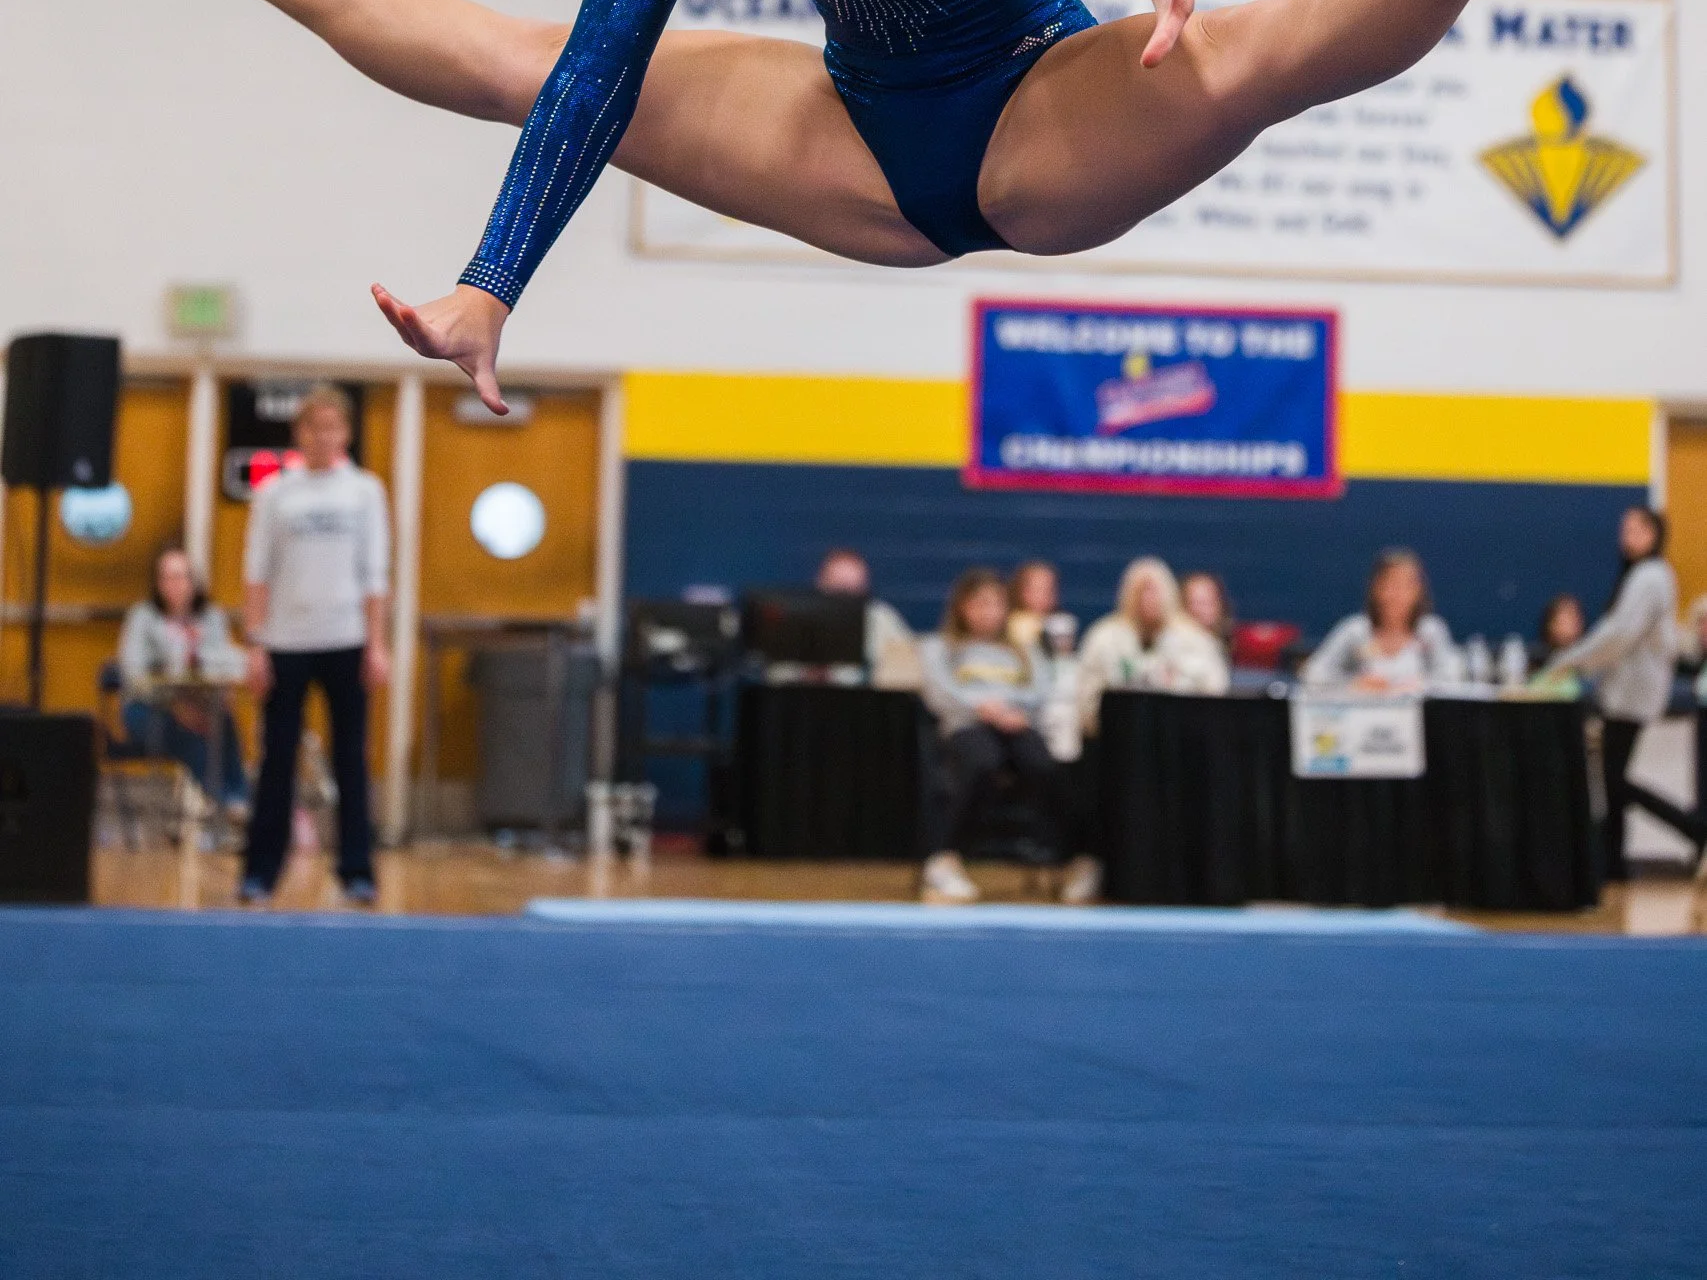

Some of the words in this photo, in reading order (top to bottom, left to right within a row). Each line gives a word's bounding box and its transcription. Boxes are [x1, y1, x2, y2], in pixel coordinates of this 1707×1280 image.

[1488, 4, 1635, 55] MATER
[996, 314, 1181, 358] WELCOME
[1186, 322, 1237, 360] TO
[1242, 324, 1316, 362] THE
[1002, 434, 1307, 479] CHAMPIONSHIPS
